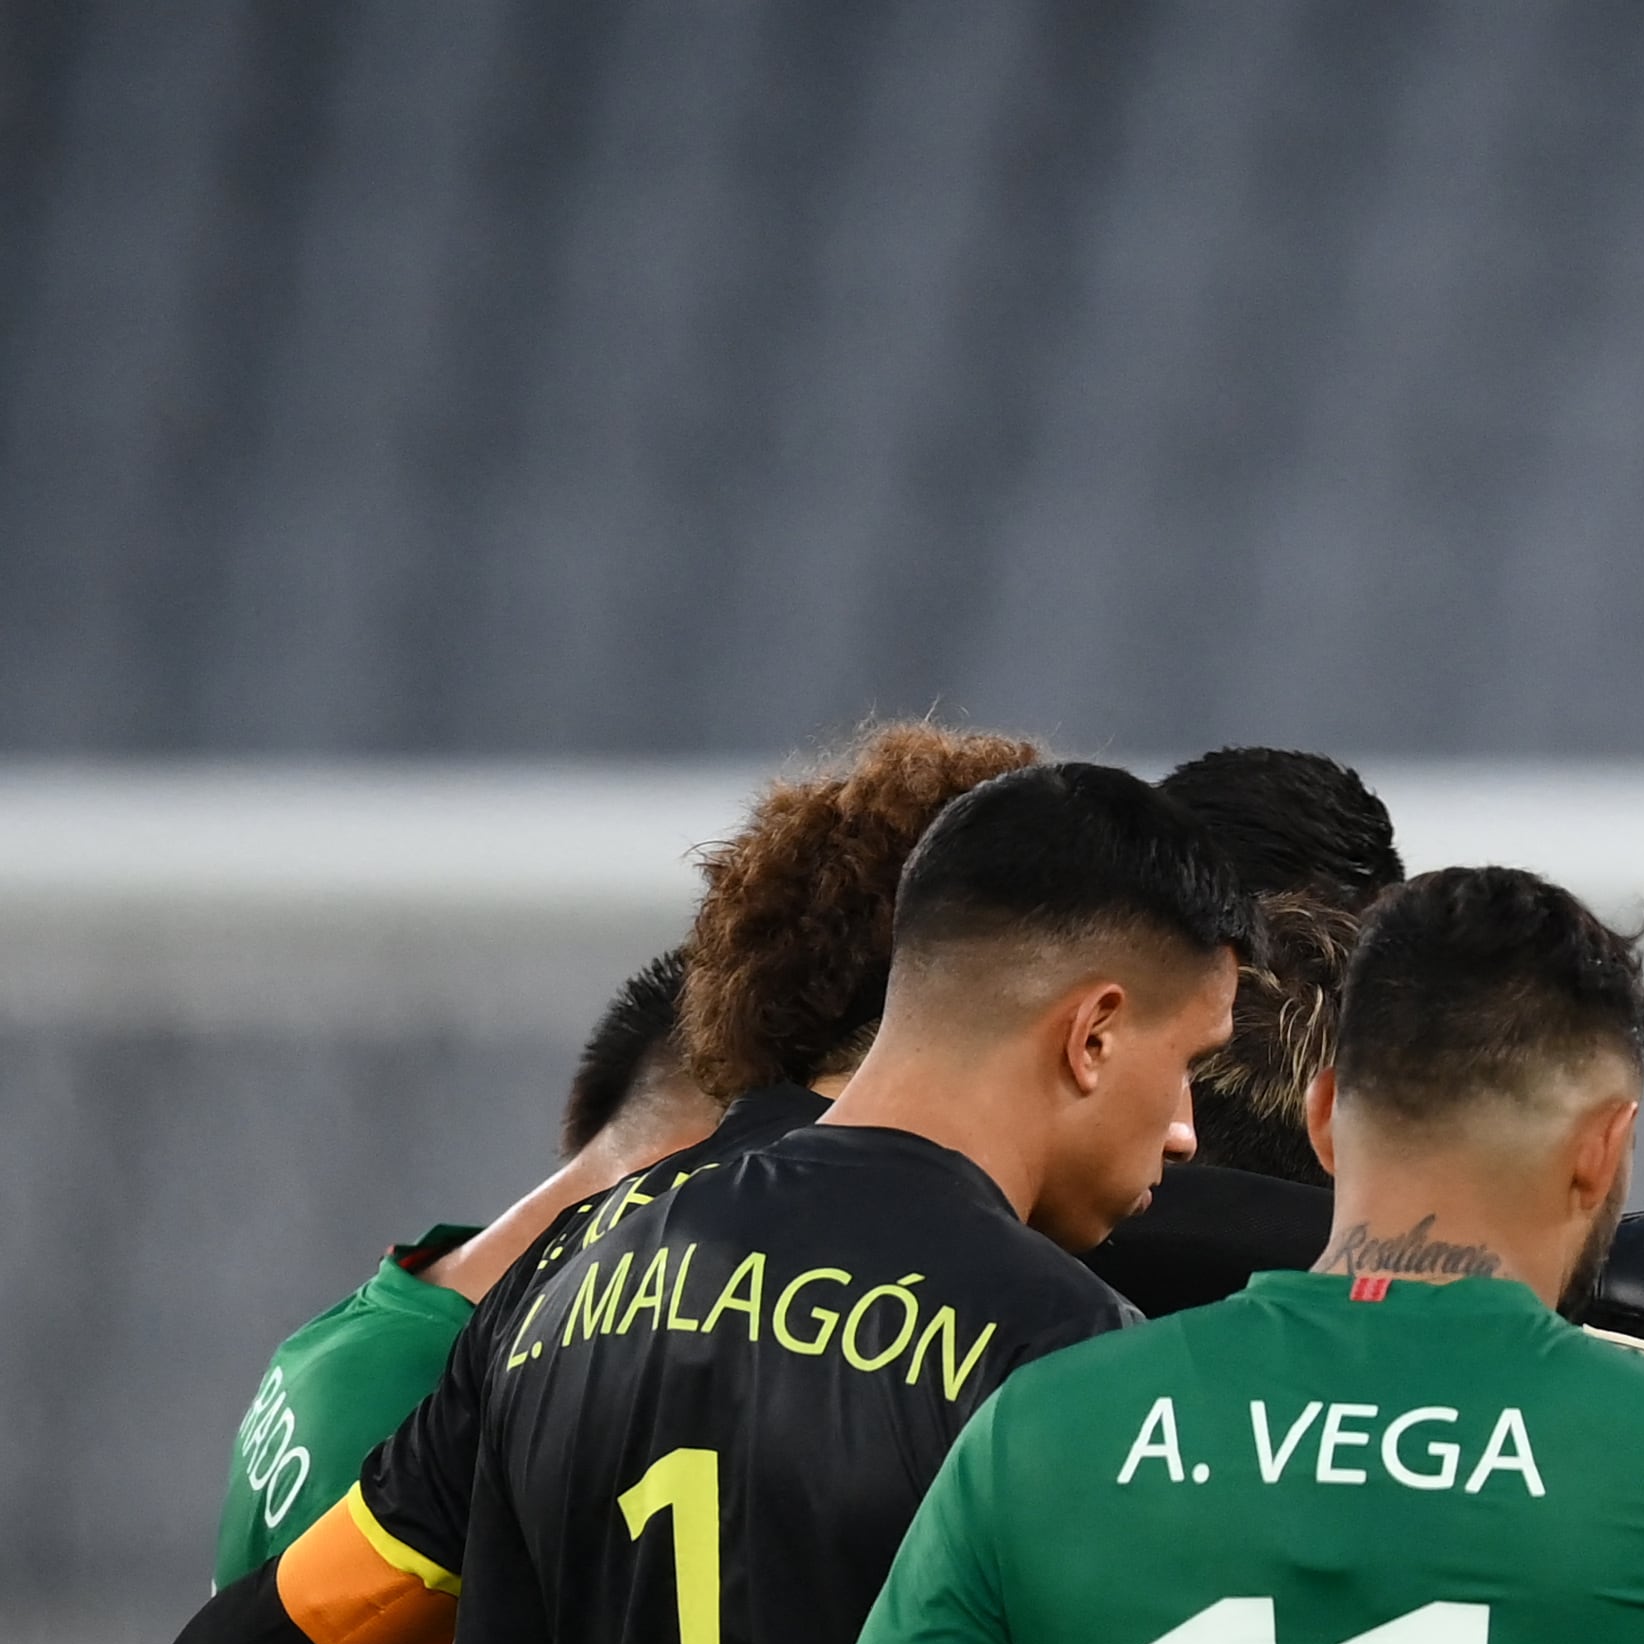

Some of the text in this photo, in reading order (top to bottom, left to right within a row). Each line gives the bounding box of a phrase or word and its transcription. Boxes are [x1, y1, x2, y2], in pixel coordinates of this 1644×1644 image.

[506, 1243, 998, 1402] L. MALAGÓN
[1116, 1397, 1546, 1497] A. VEGA
